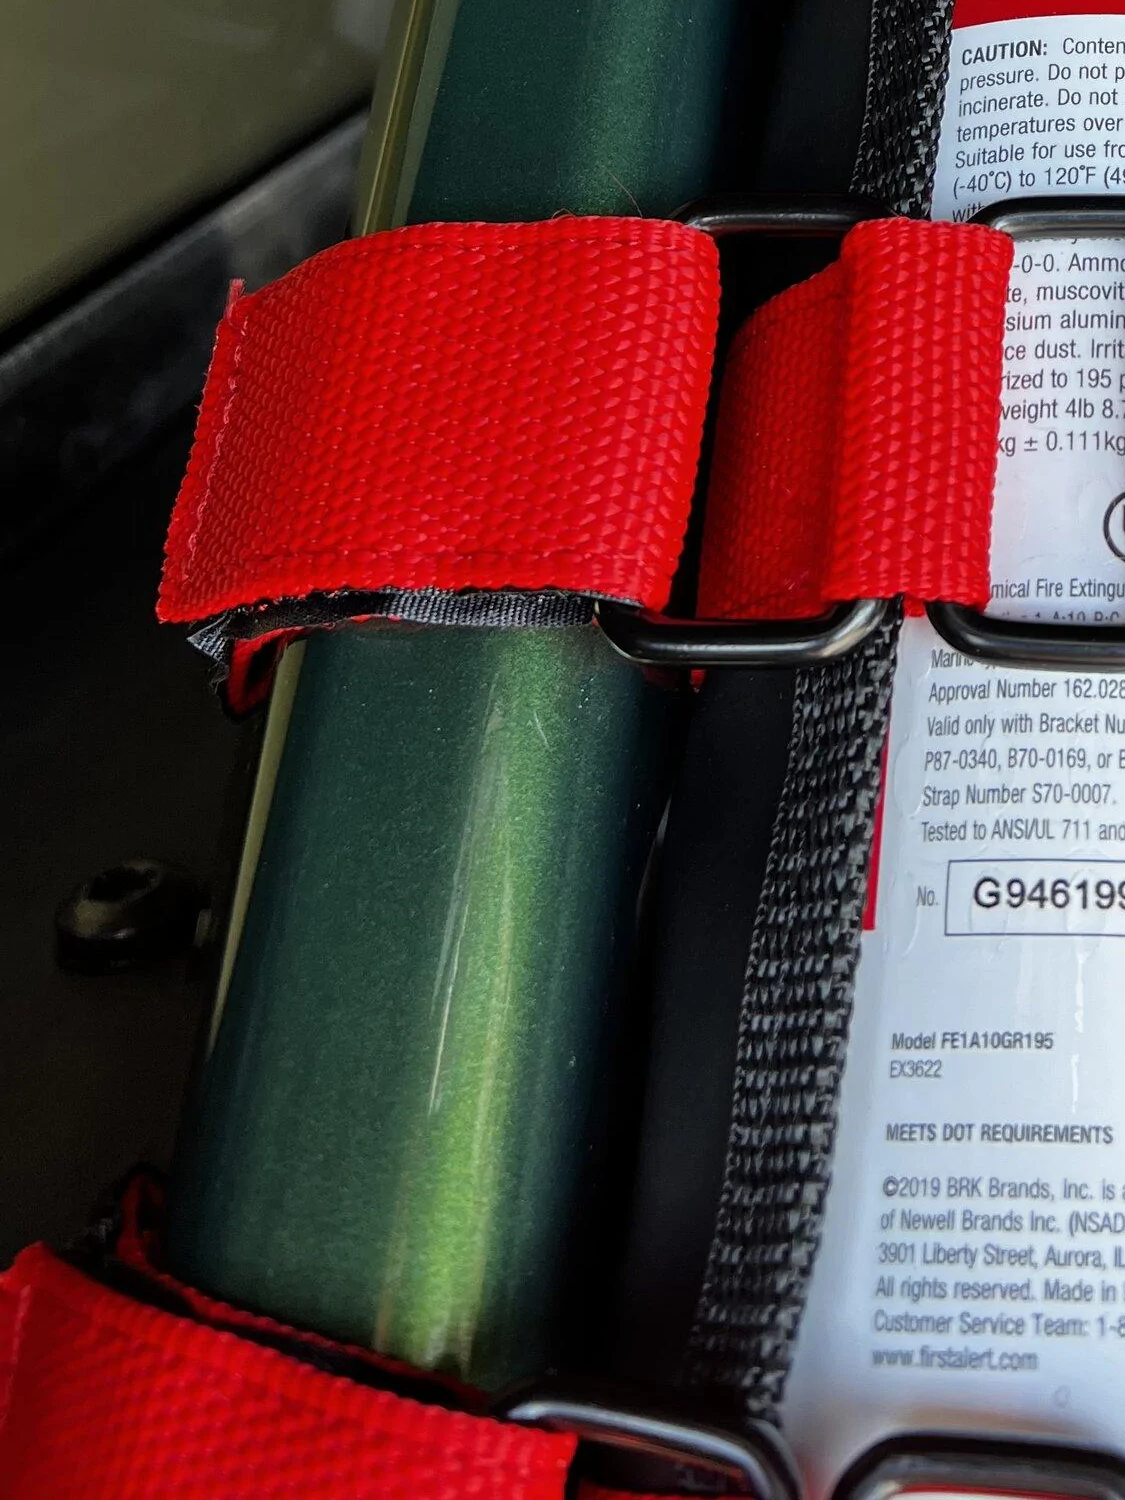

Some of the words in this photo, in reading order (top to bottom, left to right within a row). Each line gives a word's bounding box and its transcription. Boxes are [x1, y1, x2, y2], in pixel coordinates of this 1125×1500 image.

[962, 40, 1047, 65] CAUTION:
[960, 69, 1039, 95] pressure.
[1048, 64, 1071, 80] Do
[1079, 63, 1107, 79] not
[959, 91, 1048, 117] incinerate.
[1058, 89, 1081, 105] Do
[1089, 89, 1118, 105] not
[957, 117, 1075, 142] temperatures
[1084, 118, 1123, 131] over
[956, 144, 1024, 168] Suitable
[1032, 142, 1057, 159] for
[1065, 144, 1096, 158] use
[954, 171, 1012, 199] (-40°C)
[1019, 170, 1035, 187] to
[1045, 165, 1096, 185] 120°F
[1035, 339, 1080, 359] dust.
[1051, 370, 1067, 388] to
[1077, 368, 1111, 388] 195
[1065, 398, 1094, 418] 4lb
[1036, 578, 1063, 597] Fire
[929, 680, 991, 705] Approval
[997, 678, 1057, 698] Number
[928, 715, 960, 736] Valid
[965, 714, 995, 741] only
[1001, 713, 1032, 733] with
[1040, 712, 1099, 733] Bracket
[925, 749, 1001, 772] P87-0340,
[1008, 748, 1091, 771] B70-0169,
[1097, 753, 1113, 768] or
[923, 785, 960, 809] Strap
[966, 783, 1026, 804] Number
[1032, 783, 1116, 804] S70-0007.
[922, 820, 967, 842] Tested
[973, 820, 987, 840] to
[991, 818, 1055, 840] ANSI/UL
[1063, 819, 1089, 840] 711
[916, 886, 938, 906] No.
[892, 1032, 936, 1050] Model
[941, 1031, 1053, 1049] FE1A10GR195
[890, 1059, 942, 1078] EX3622
[887, 1123, 936, 1142] MEETS
[943, 1123, 975, 1142] DOT
[981, 1124, 1113, 1144] REQUIREMENTS
[947, 1177, 982, 1198] BRK
[989, 1177, 1054, 1201] Brands,
[1063, 1178, 1093, 1200] Inc.
[1102, 1179, 1115, 1201] is
[880, 1209, 896, 1230] of
[900, 1209, 955, 1231] Newell
[961, 1209, 1023, 1232] Brands
[1030, 1211, 1060, 1233] Inc.
[879, 1242, 915, 1264] 3901
[923, 1243, 978, 1269] Liberty
[983, 1243, 1038, 1269] Street,
[1044, 1245, 1106, 1270] Aurora,
[875, 1276, 894, 1298] All
[900, 1276, 947, 1304] rights
[953, 1279, 1035, 1301] reserved.
[1044, 1279, 1094, 1302] Made
[1101, 1280, 1117, 1302] in
[874, 1309, 954, 1334] Customer
[959, 1311, 1026, 1336] Service
[1032, 1313, 1088, 1337] Team:
